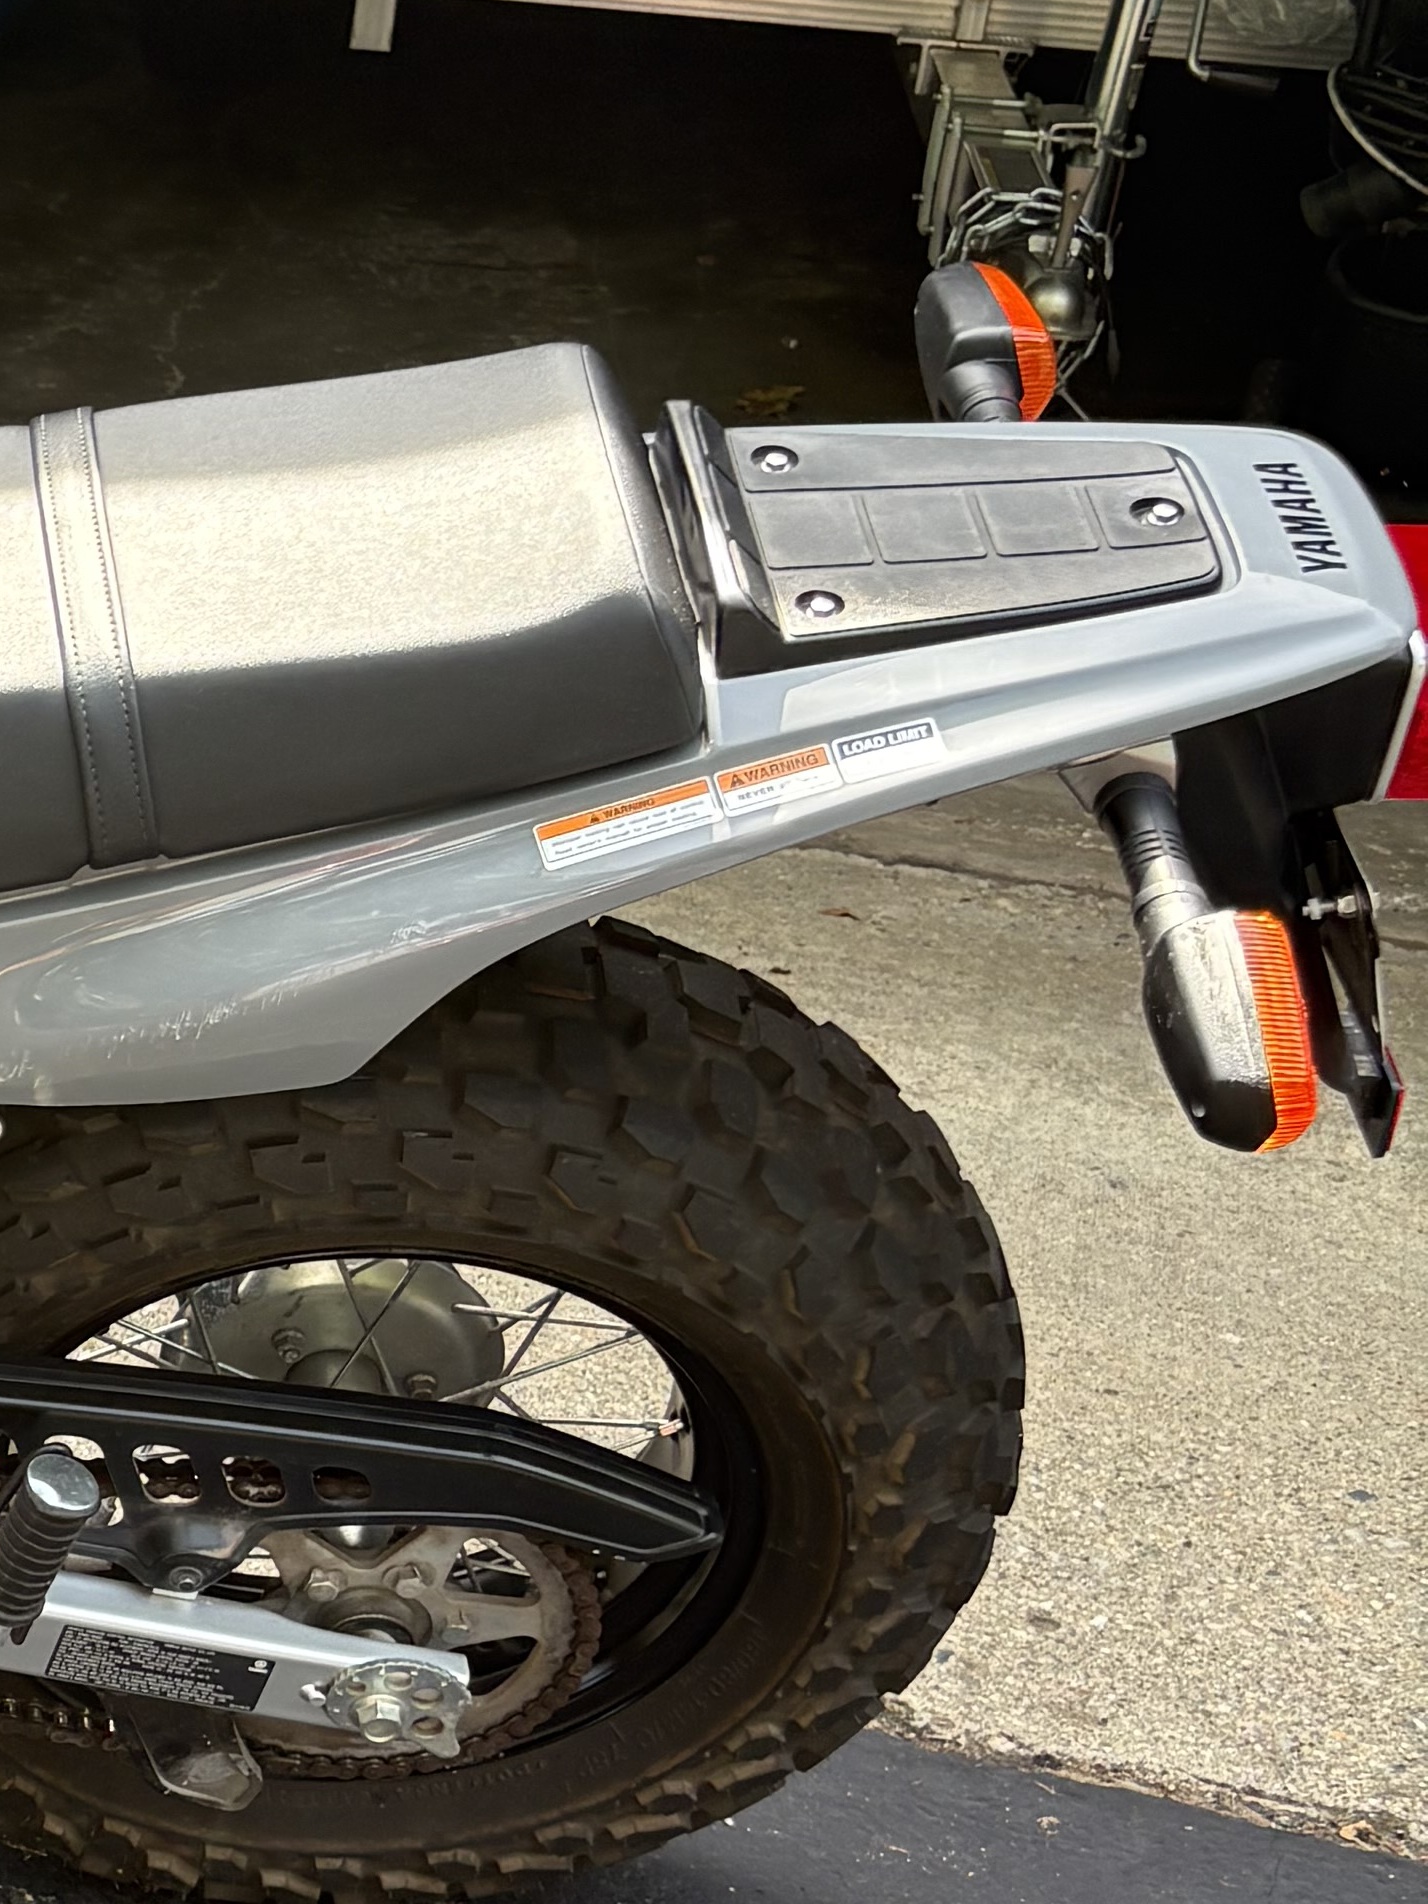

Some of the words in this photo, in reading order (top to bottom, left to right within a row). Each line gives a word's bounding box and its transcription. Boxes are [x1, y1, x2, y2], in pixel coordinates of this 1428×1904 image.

[1252, 462, 1348, 573] YAMAHA
[842, 735, 886, 756] LOAD
[887, 725, 929, 746] LIMIT
[743, 754, 819, 783] WARNING
[602, 798, 655, 818] WARNING
